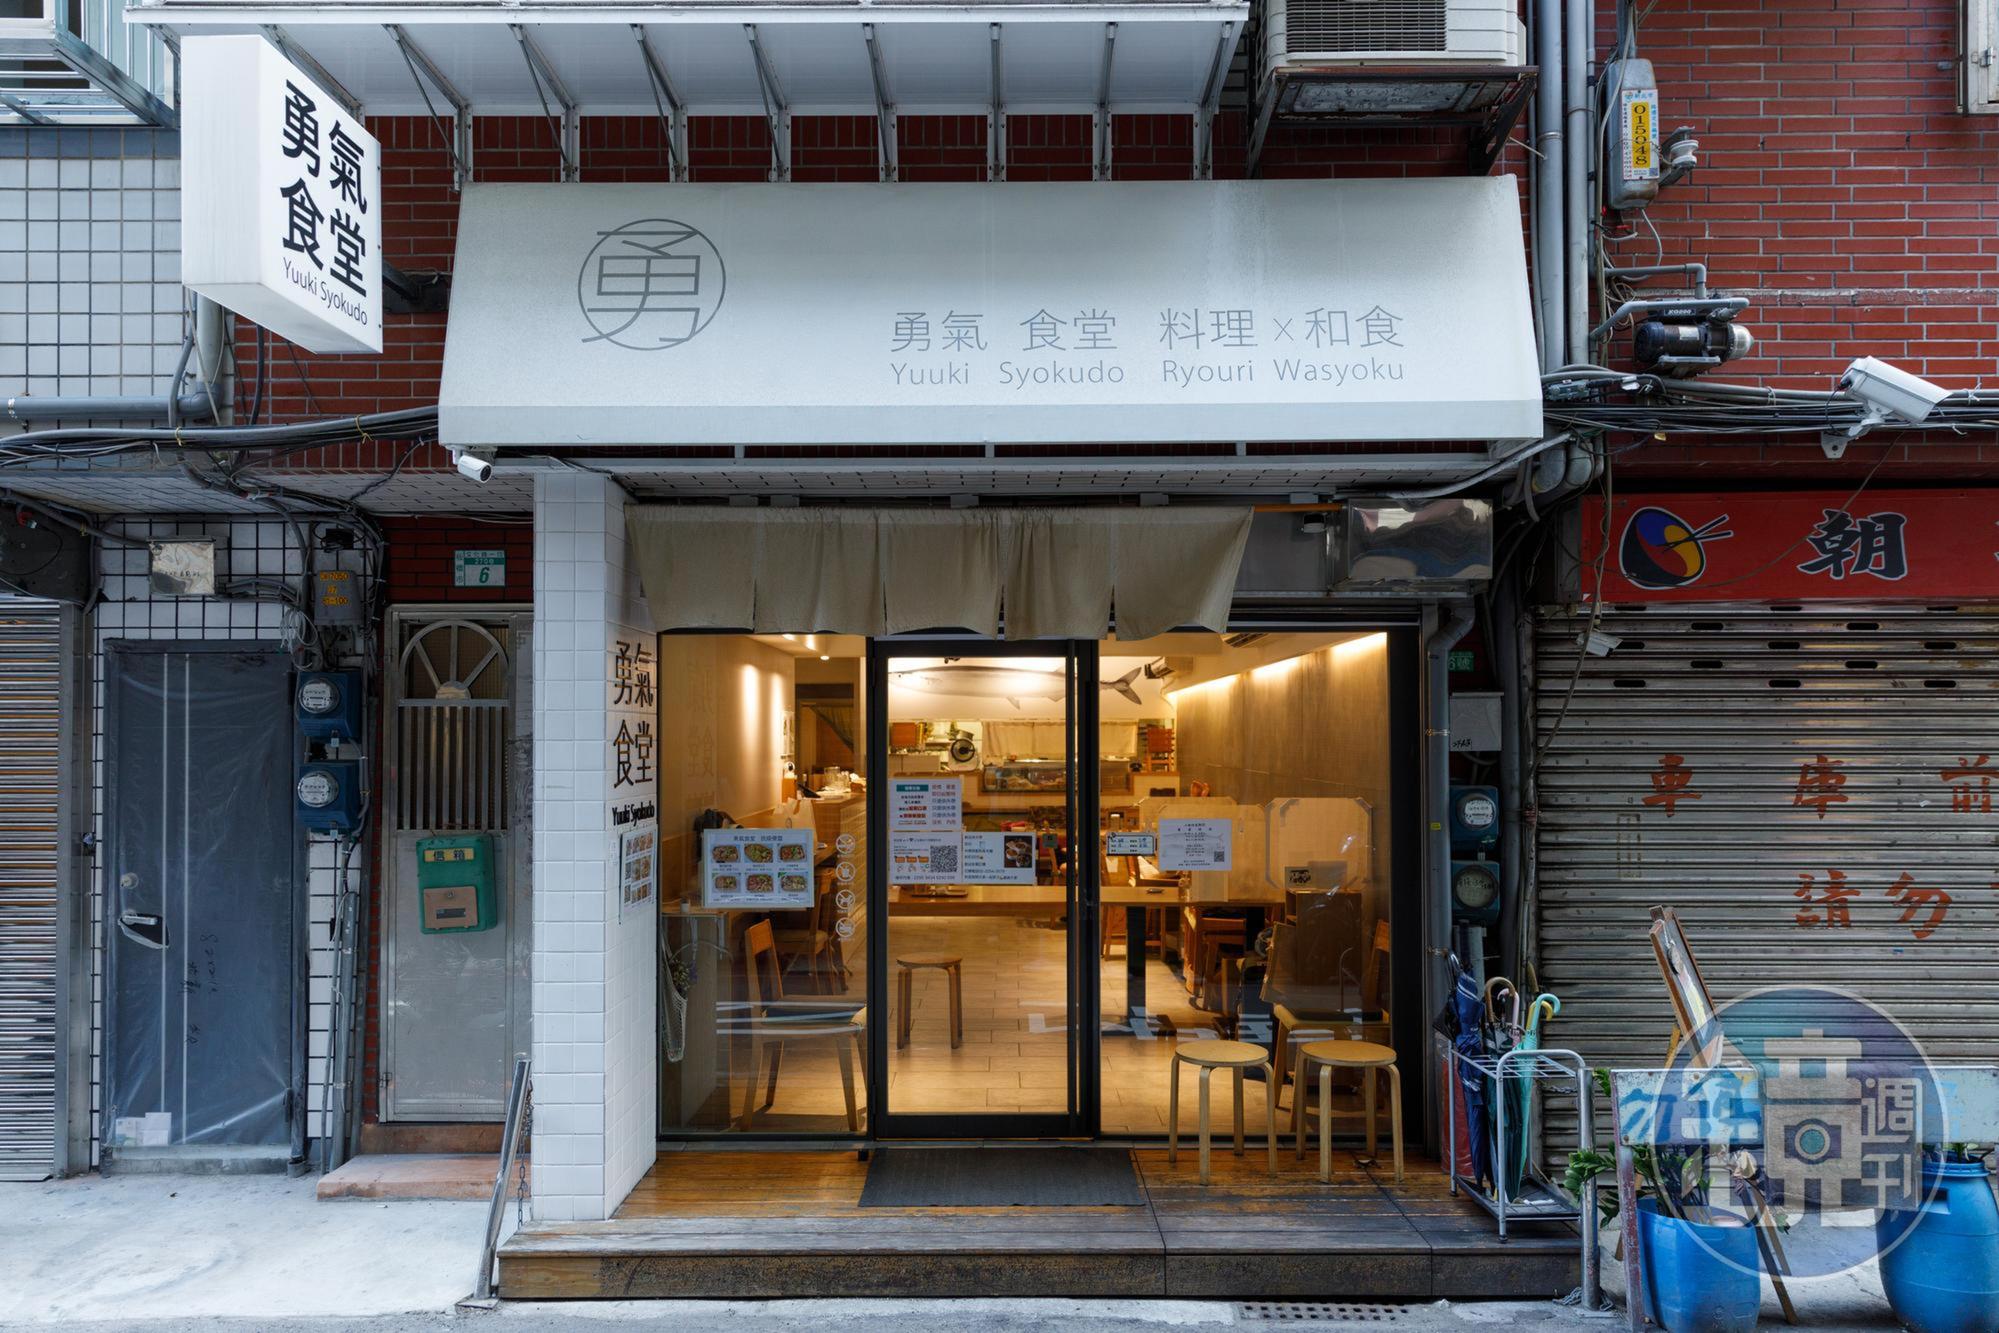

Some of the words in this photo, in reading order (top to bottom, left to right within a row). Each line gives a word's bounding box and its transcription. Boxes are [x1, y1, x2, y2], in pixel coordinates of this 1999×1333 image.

[282, 79, 367, 214] 勇氣
[1633, 104, 1648, 166] 015048
[280, 177, 368, 298] 食堂
[283, 256, 318, 295] Yuuki
[320, 280, 368, 326] Syokudo
[891, 310, 987, 353] 勇氣
[1020, 308, 1118, 352] 食堂
[890, 362, 971, 387] Yuuki
[999, 360, 1125, 388] Syokudo
[1161, 359, 1255, 386] Ryouri
[1273, 358, 1405, 386] Wasyoku
[479, 566, 490, 584] 6
[1797, 508, 1908, 580] 朝
[613, 640, 653, 707] 勇氣
[613, 719, 653, 788] 食堂
[612, 804, 630, 826] Yuuki
[630, 800, 655, 827] Syokudo
[1795, 870, 1999, 939] 請勿
